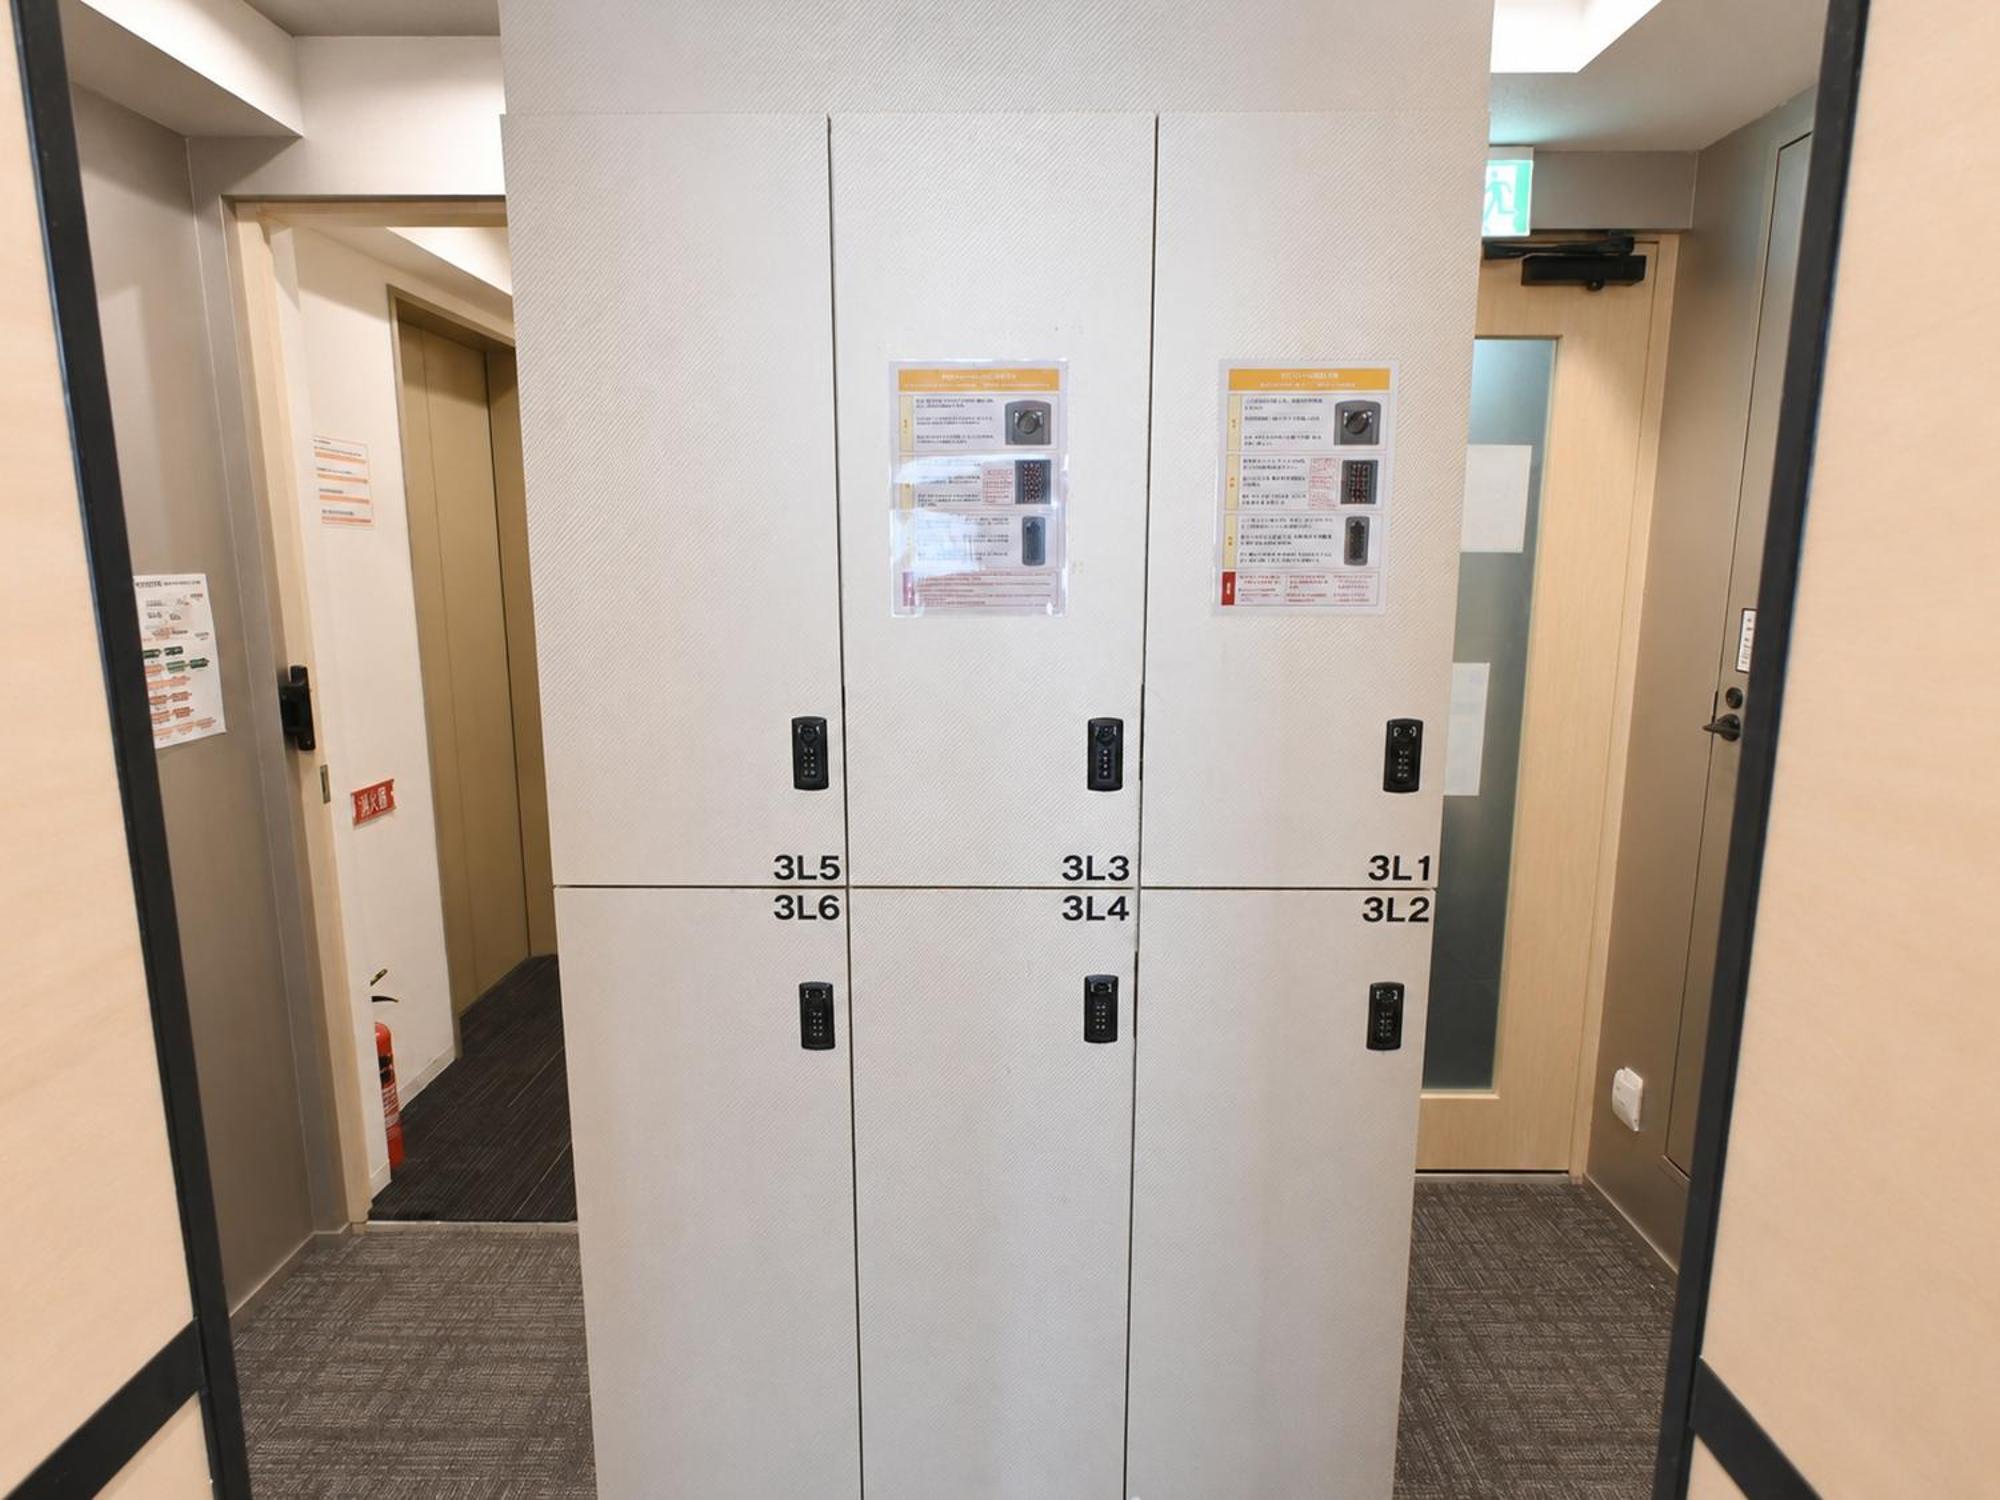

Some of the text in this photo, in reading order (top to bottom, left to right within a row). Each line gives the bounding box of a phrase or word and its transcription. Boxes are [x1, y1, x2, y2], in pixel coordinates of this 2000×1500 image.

[774, 855, 840, 881] 3L5
[1063, 855, 1130, 882] 3L3
[1368, 855, 1431, 882] 3L1
[774, 895, 840, 921] 3L6
[1062, 896, 1130, 922] 3L4
[1362, 897, 1430, 923] 3L2
